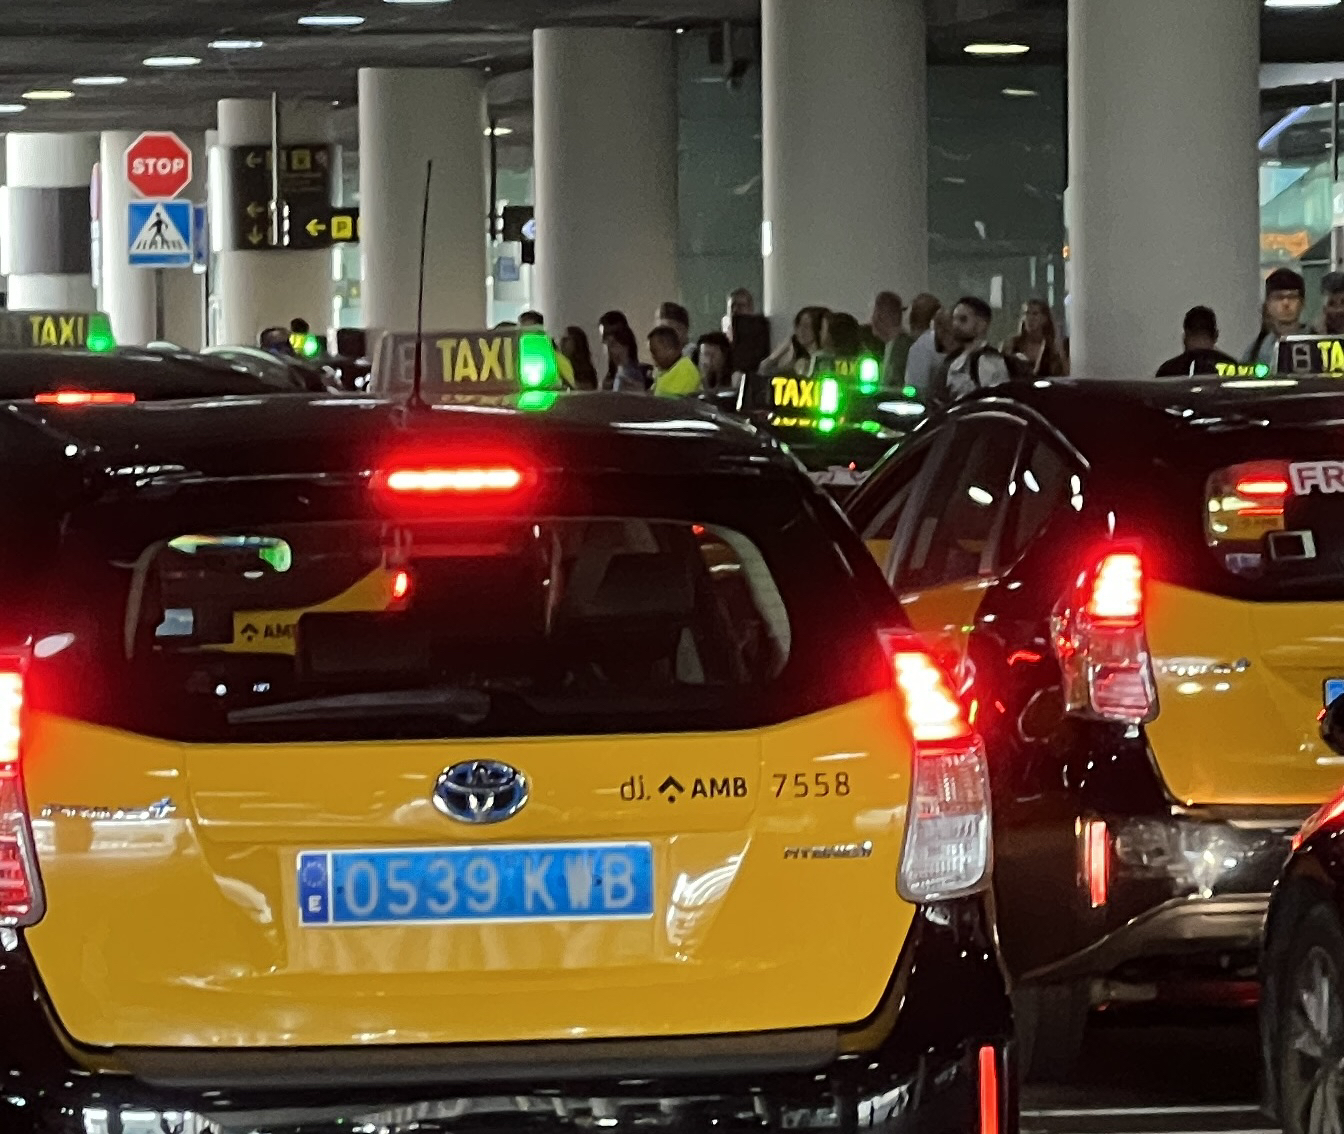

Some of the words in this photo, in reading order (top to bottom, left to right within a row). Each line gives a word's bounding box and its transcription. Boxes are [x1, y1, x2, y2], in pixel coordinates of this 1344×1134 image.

[132, 158, 184, 175] STOP
[29, 315, 84, 347] TAXI
[436, 337, 514, 382] TAXI
[771, 377, 820, 407] TAXI
[263, 623, 297, 639] AM
[620, 775, 651, 801] dj.
[691, 777, 748, 799] AMB
[773, 771, 850, 798] 7558
[308, 895, 322, 913] E
[344, 855, 499, 917] 0539
[522, 852, 635, 911] KWB
